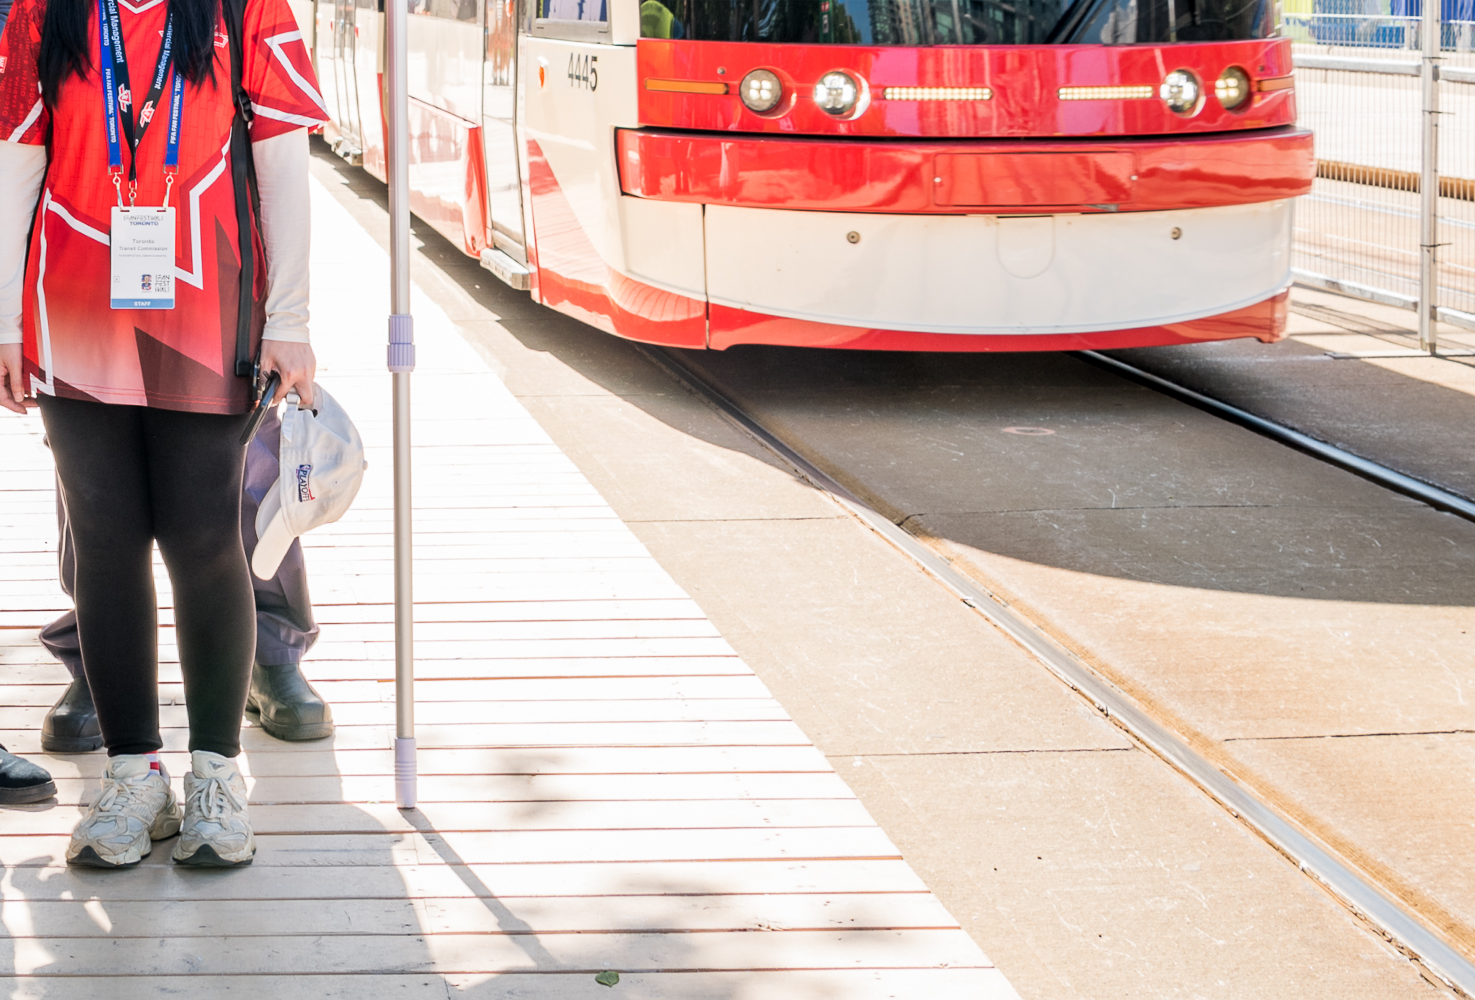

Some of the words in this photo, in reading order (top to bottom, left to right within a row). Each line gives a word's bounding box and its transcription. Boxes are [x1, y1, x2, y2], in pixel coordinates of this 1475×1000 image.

[110, 15, 124, 63] Management
[154, 50, 171, 89] Management
[567, 52, 598, 92] 4445
[109, 117, 117, 143] TORONTO
